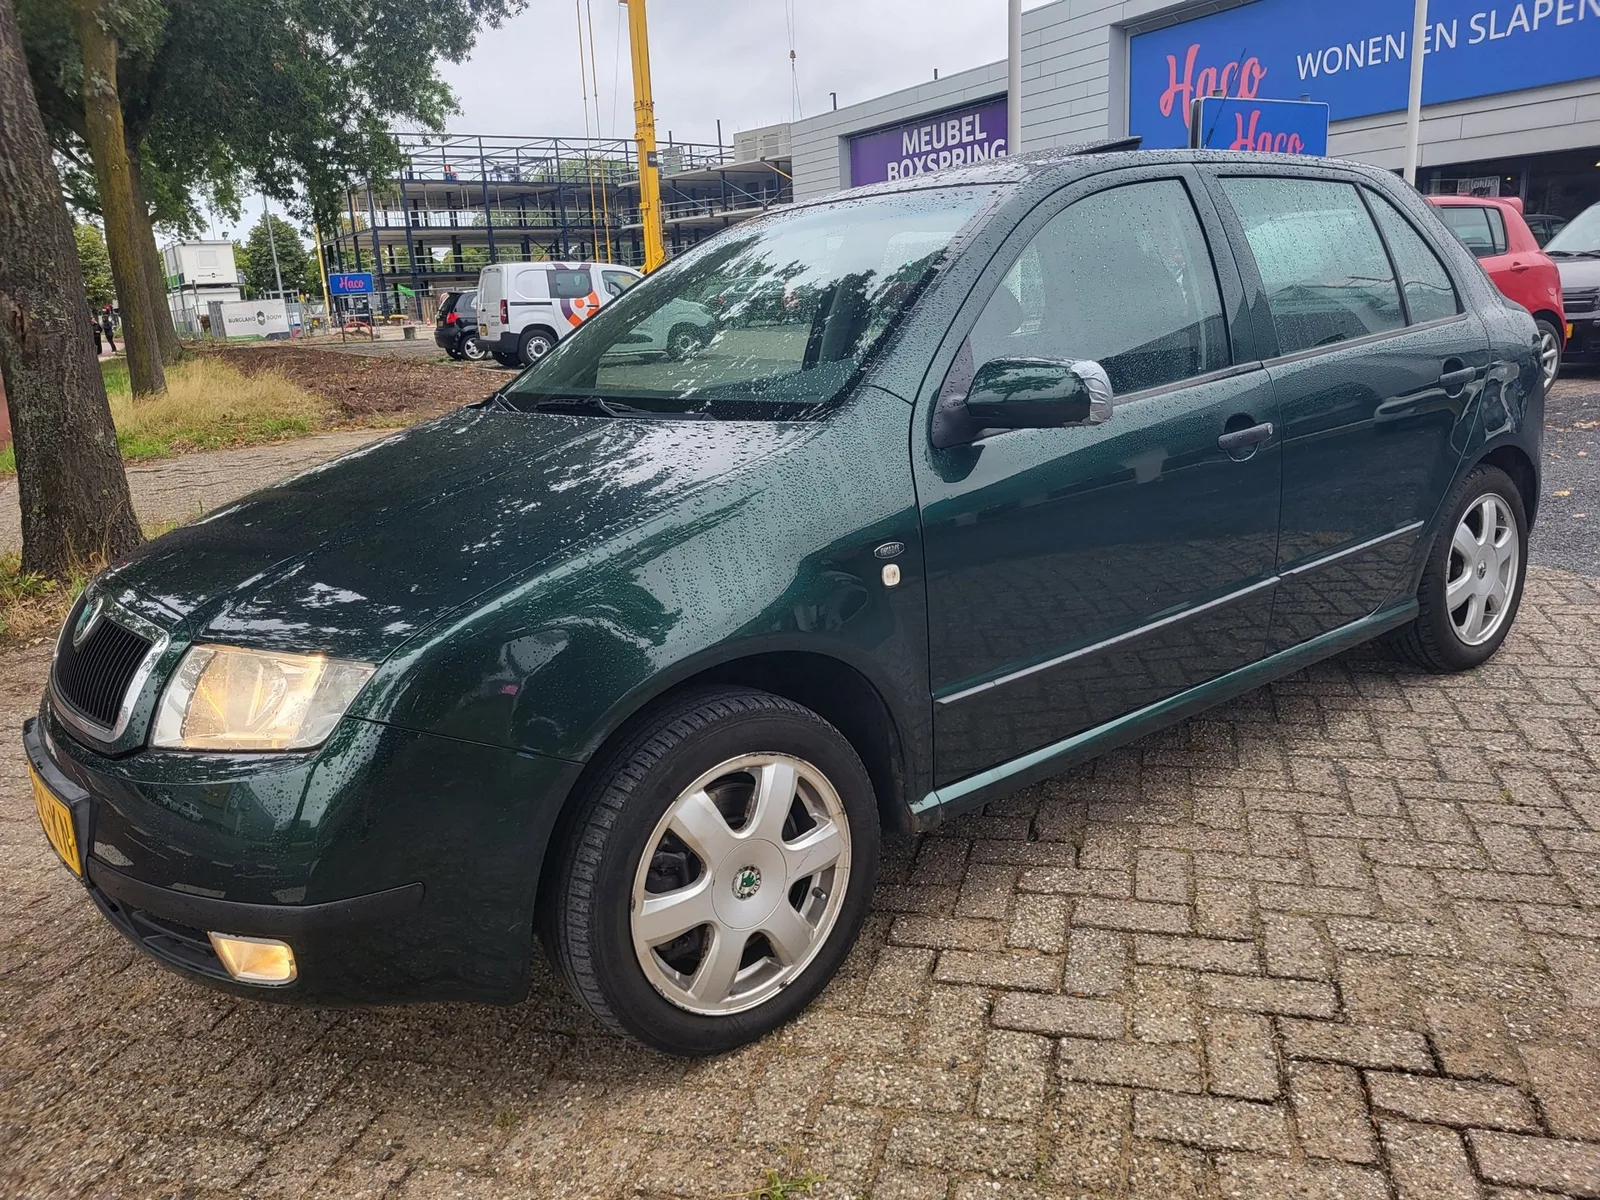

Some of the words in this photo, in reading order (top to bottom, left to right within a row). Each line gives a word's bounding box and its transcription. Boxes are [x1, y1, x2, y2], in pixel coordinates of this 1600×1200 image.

[1297, 31, 1405, 80] WONEN
[1160, 44, 1267, 129] Haco
[902, 113, 987, 156] MEUBEL
[339, 276, 364, 291] Haco
